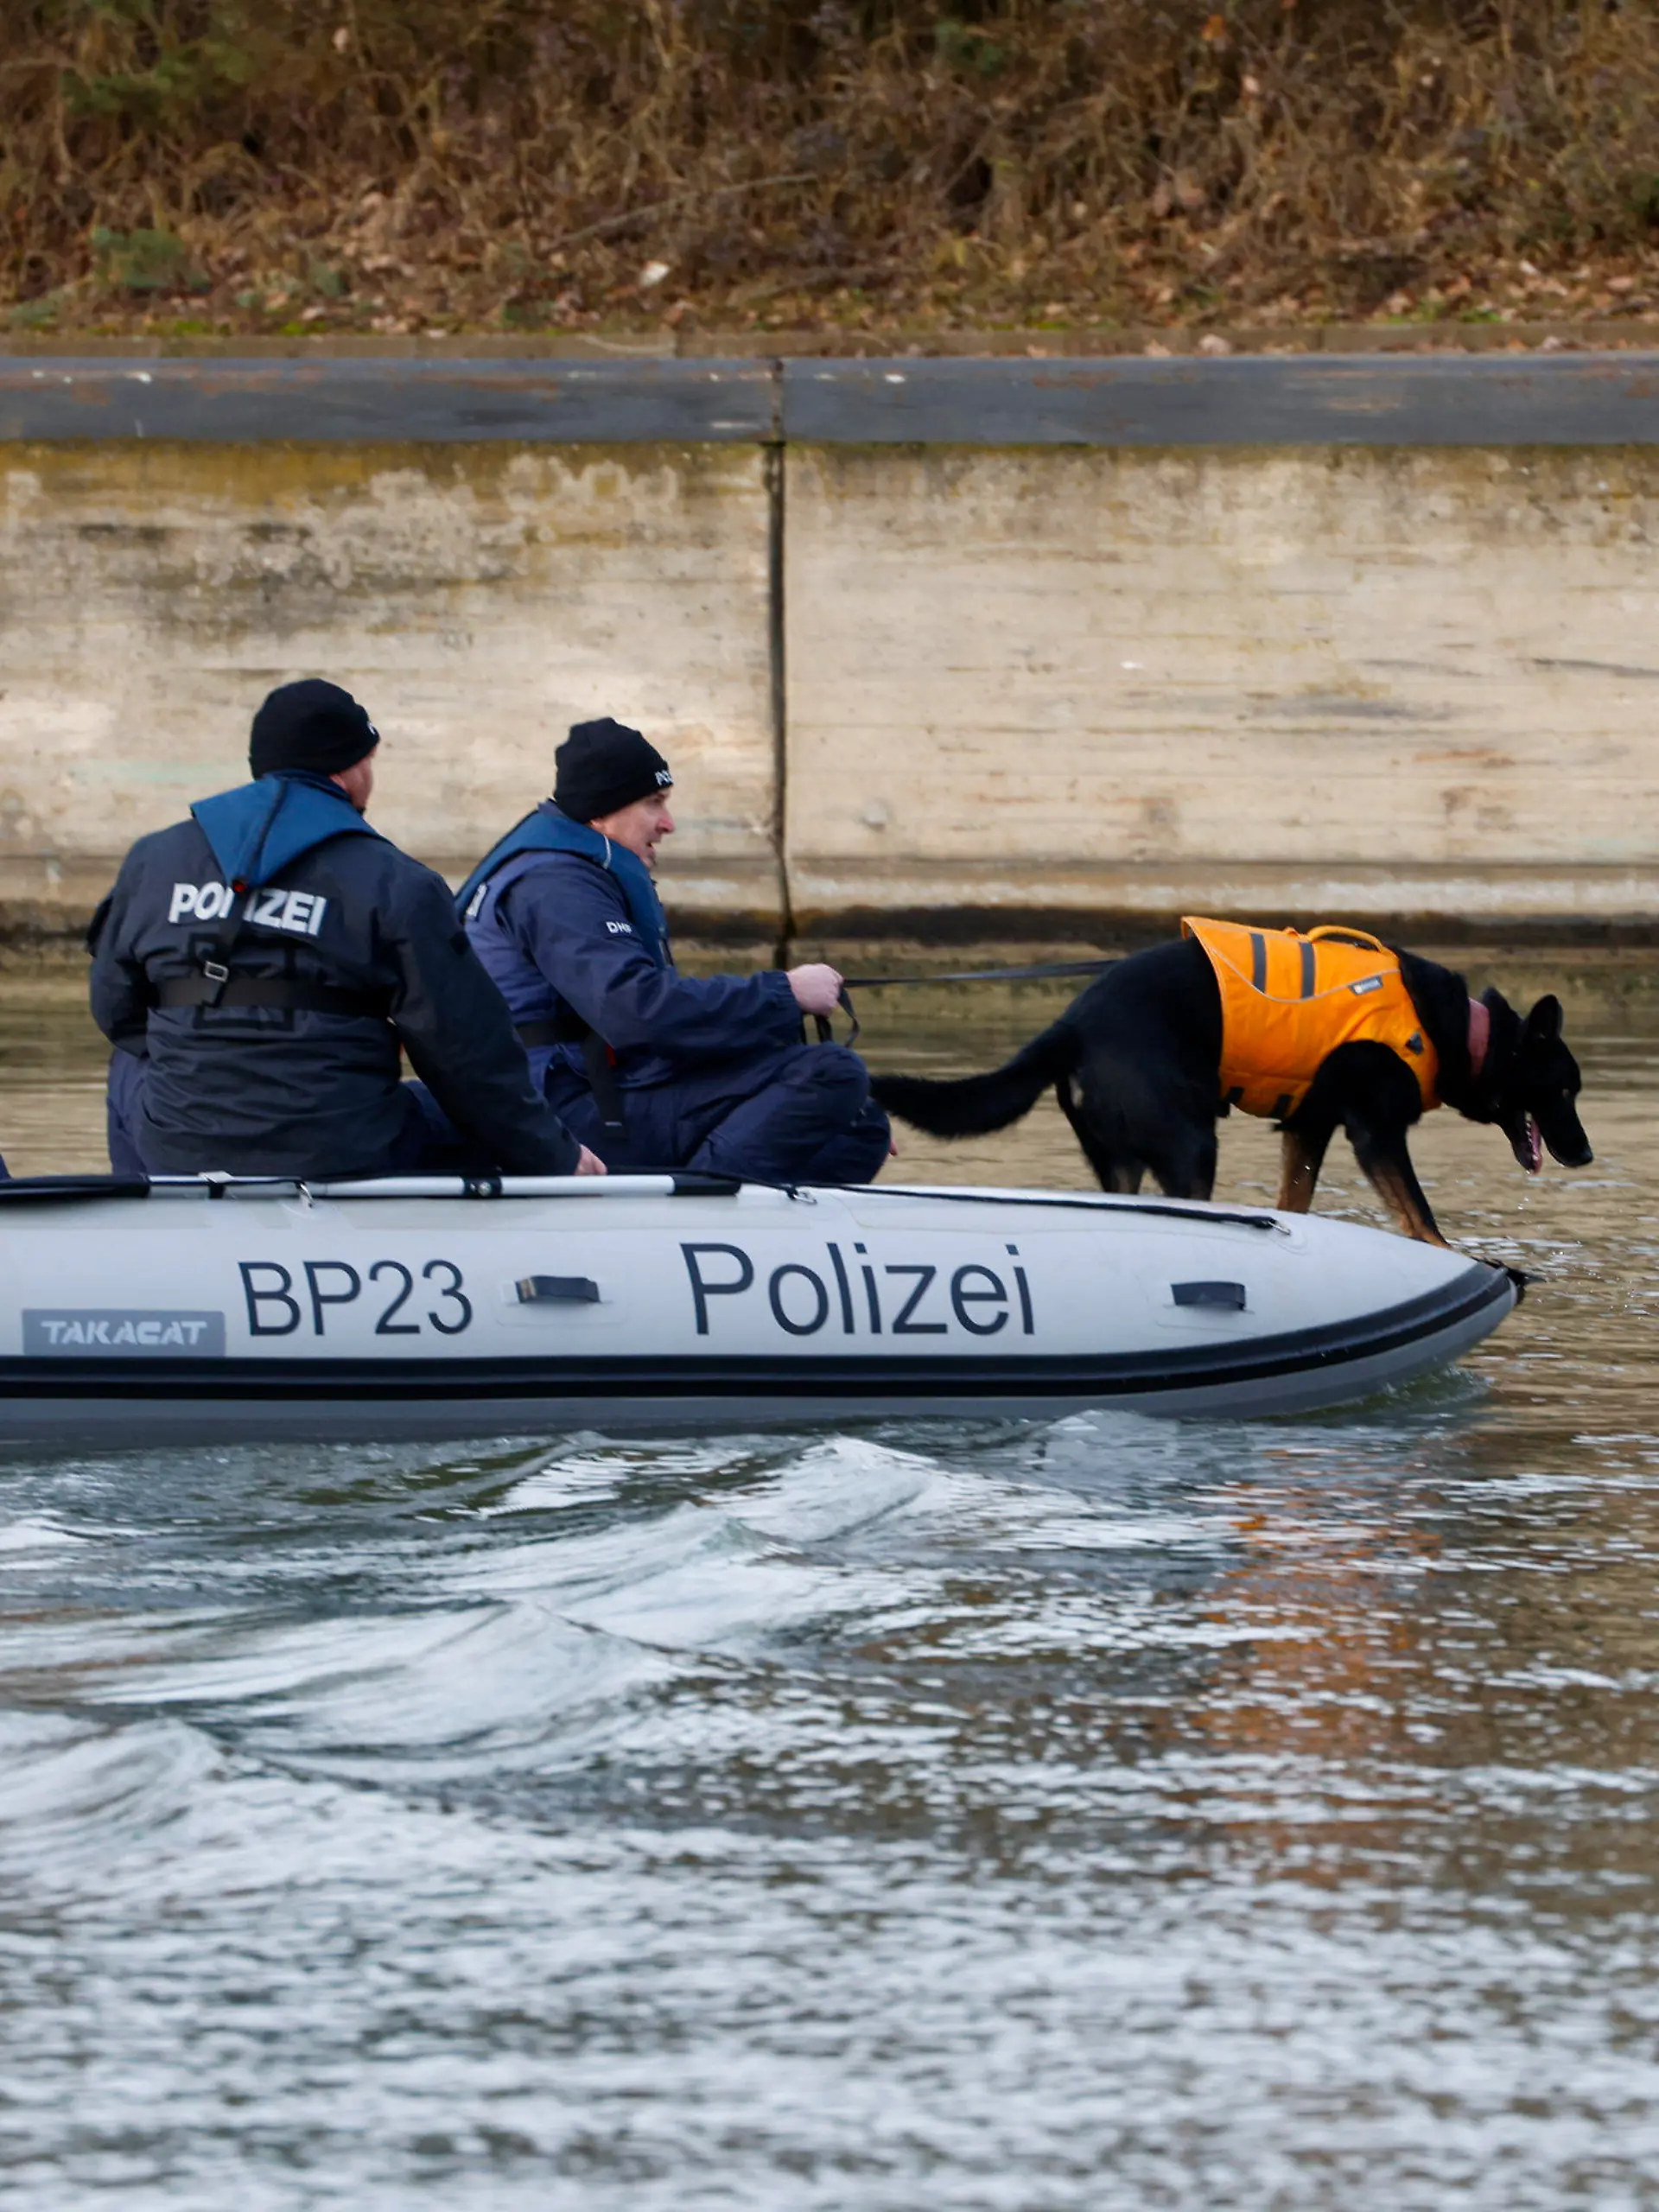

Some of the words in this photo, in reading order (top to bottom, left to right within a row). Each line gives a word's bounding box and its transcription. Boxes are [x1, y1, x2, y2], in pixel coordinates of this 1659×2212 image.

[238, 1259, 473, 1336] BP23
[679, 1242, 1035, 1336] Polizei
[41, 1320, 207, 1345] TAKACAT
